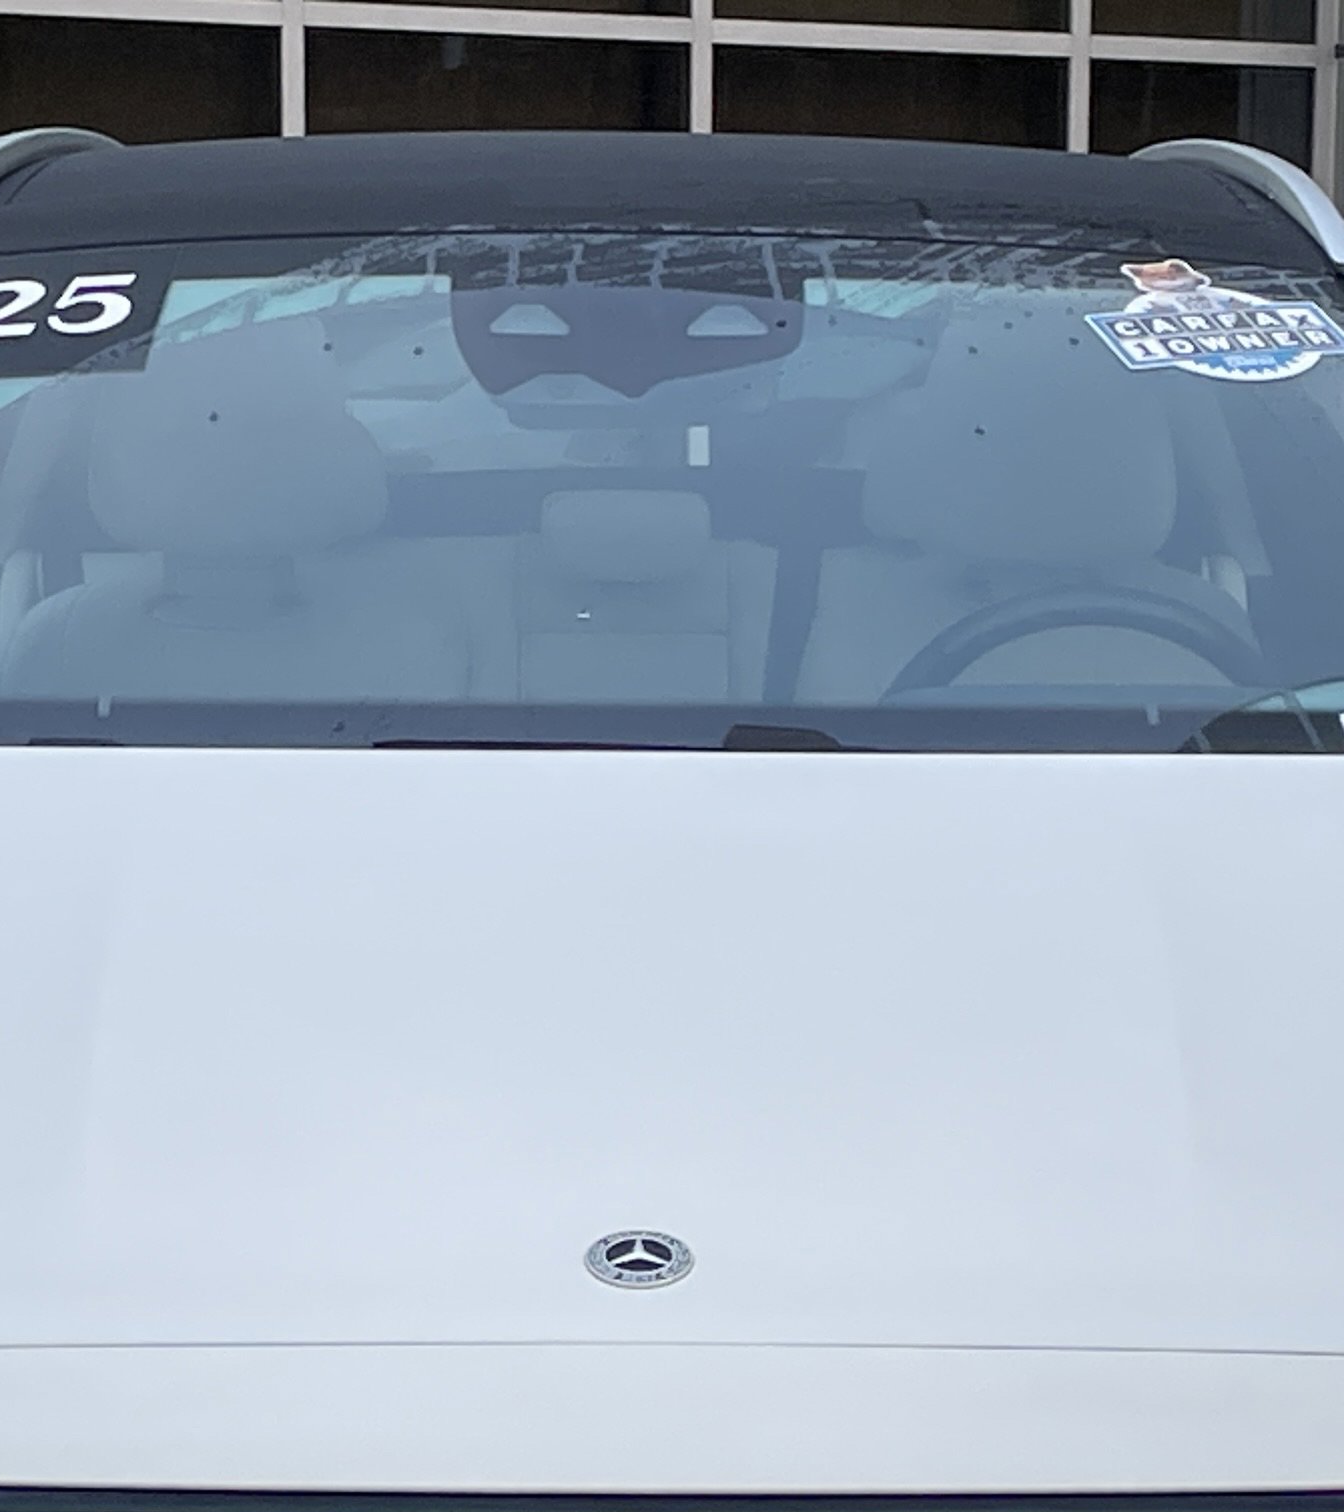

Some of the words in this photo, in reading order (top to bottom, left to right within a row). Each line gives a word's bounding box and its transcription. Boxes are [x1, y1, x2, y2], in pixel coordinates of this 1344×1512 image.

[1112, 311, 1325, 337] CARFAX
[1137, 340, 1161, 357] 1
[1166, 329, 1336, 355] OWNER
